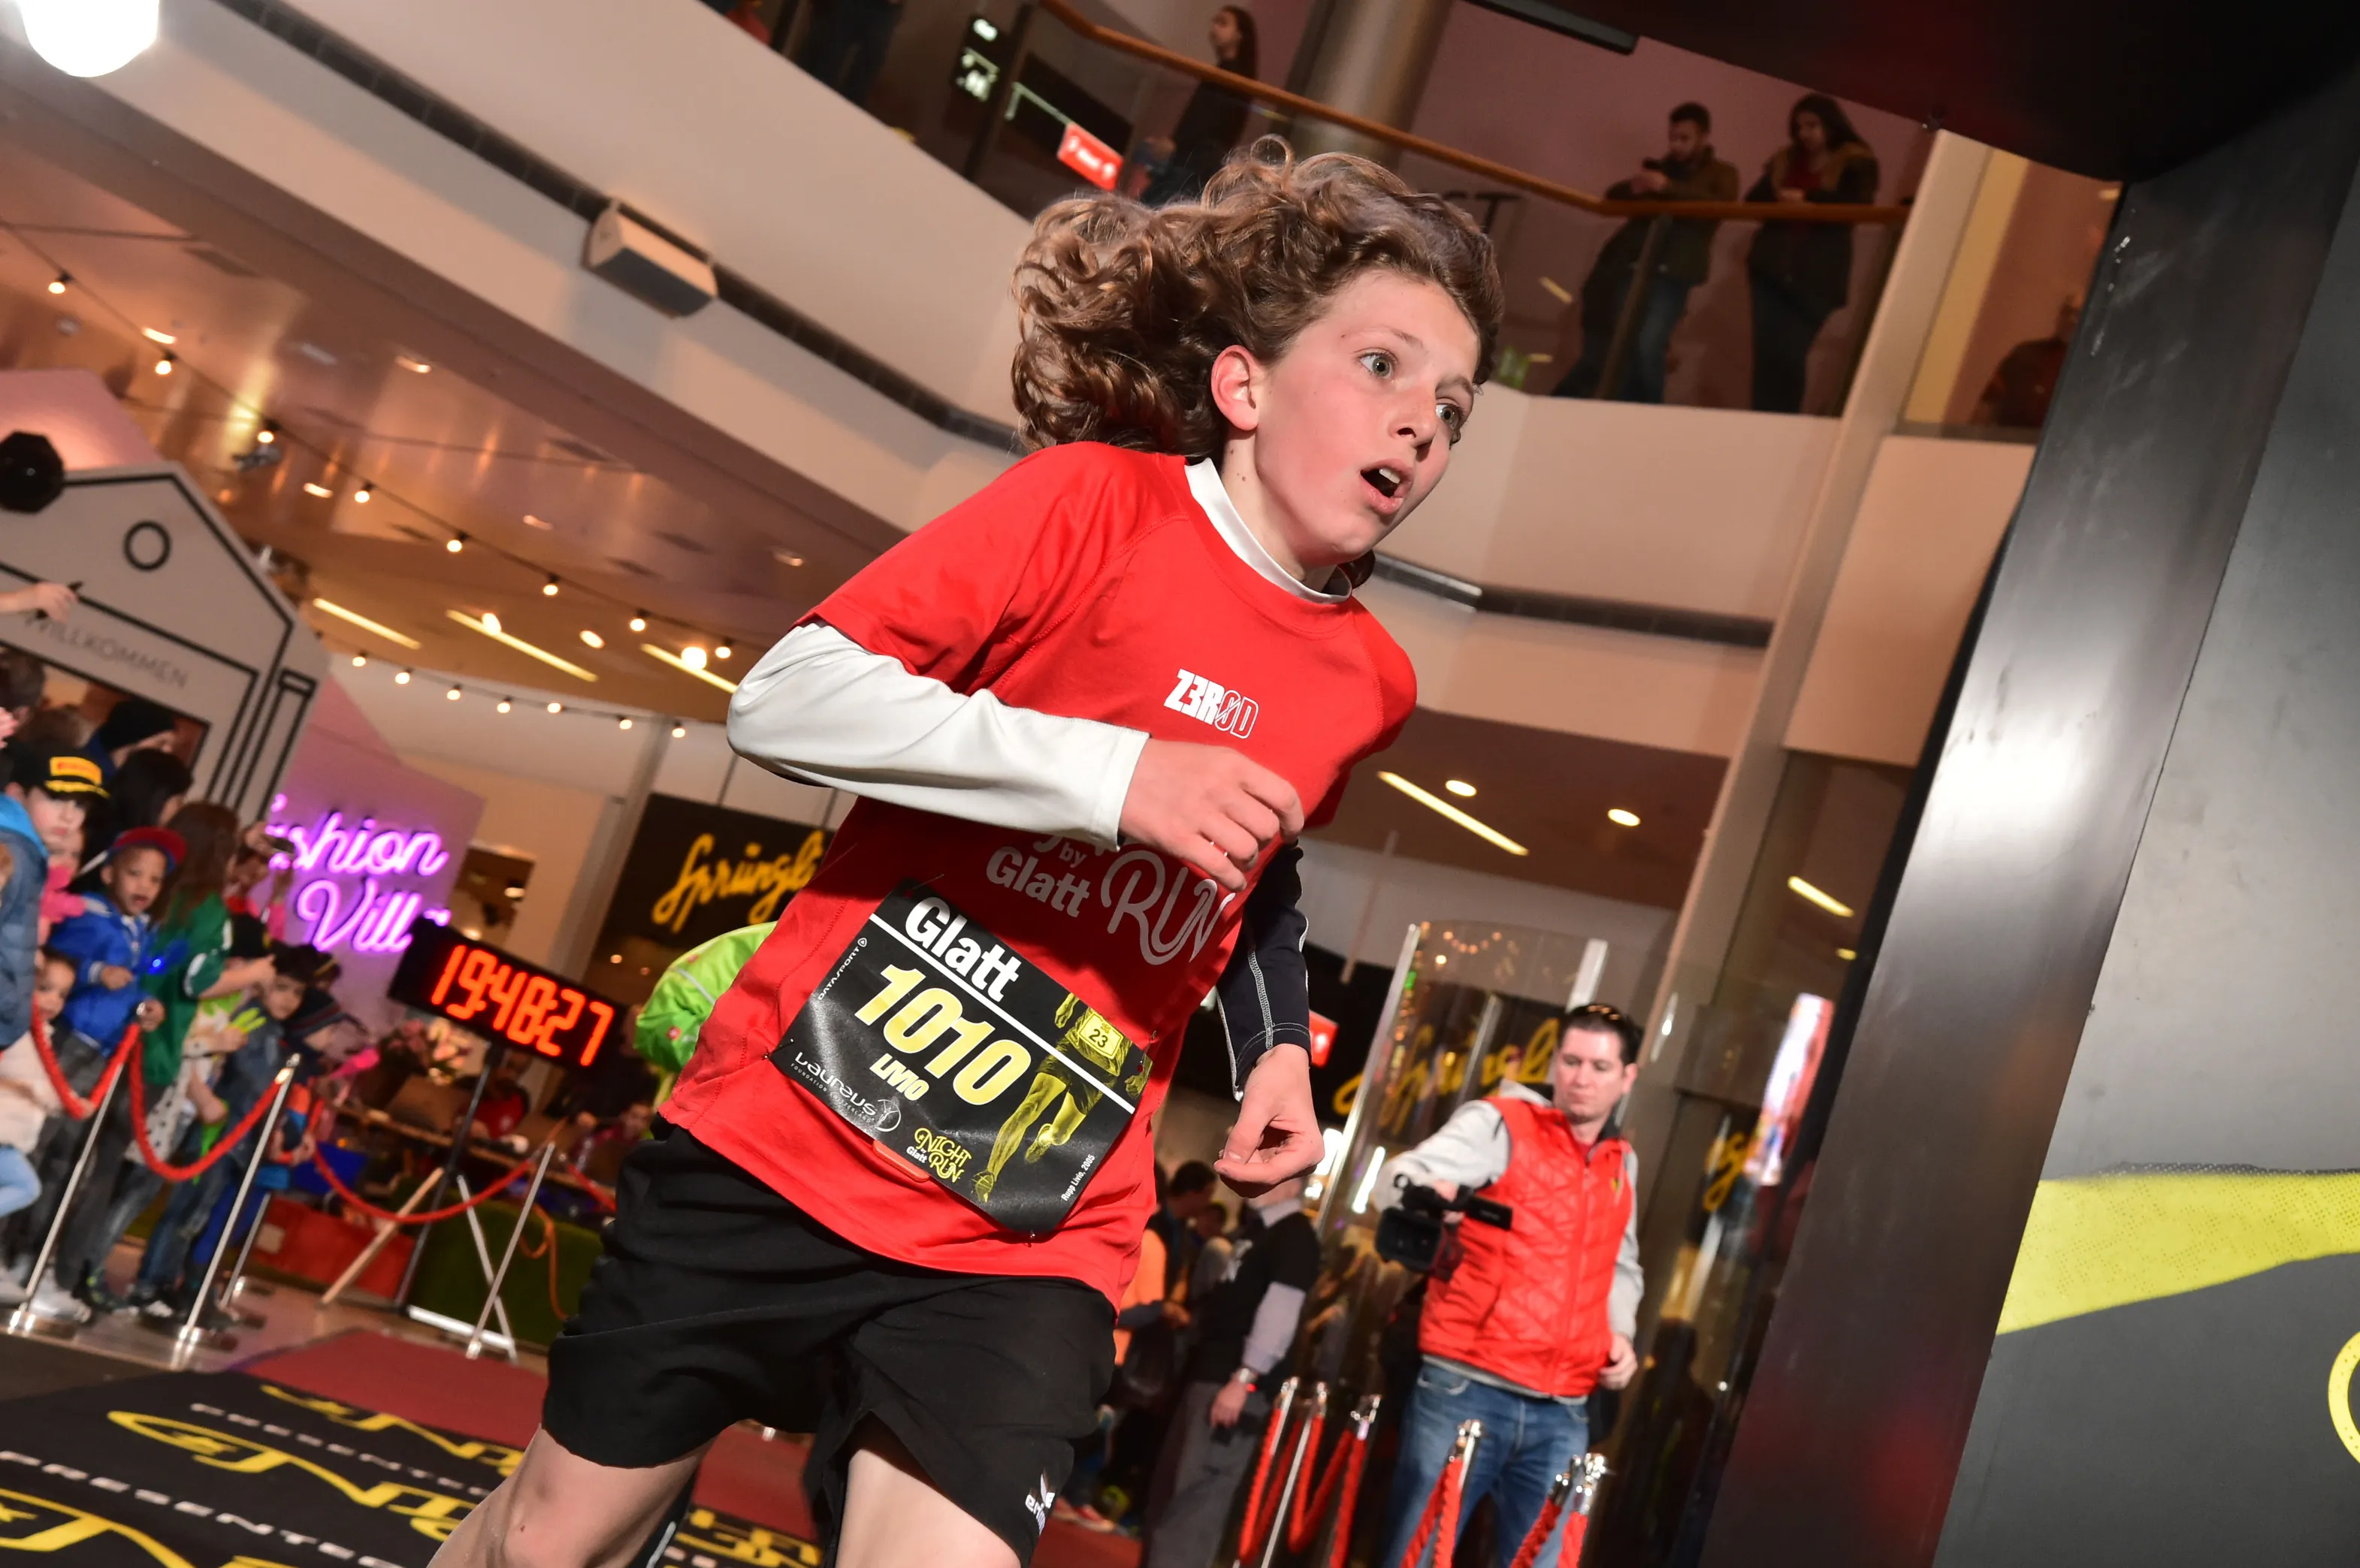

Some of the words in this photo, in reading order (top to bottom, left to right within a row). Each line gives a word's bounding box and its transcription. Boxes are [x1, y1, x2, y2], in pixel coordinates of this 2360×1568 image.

[266, 793, 449, 876] shion
[1059, 842, 1088, 869] by
[986, 846, 1091, 918] Glatt
[297, 878, 451, 953] Vill
[1100, 849, 1237, 966] RUN
[817, 946, 860, 1001] DATASPORT
[905, 896, 1023, 1003] Glatt
[854, 963, 1032, 1106] 1010
[1088, 1028, 1109, 1048] 23
[790, 1062, 828, 1092] FOUNDATION
[869, 1053, 930, 1101] LIVIO
[905, 1146, 928, 1164] Glatt
[914, 1127, 972, 1168] NIGHT
[928, 1152, 965, 1183] RUN
[1061, 1184, 1076, 1202] Rupp
[1070, 1171, 1086, 1186] Livio,
[1080, 1153, 1095, 1171] 2005
